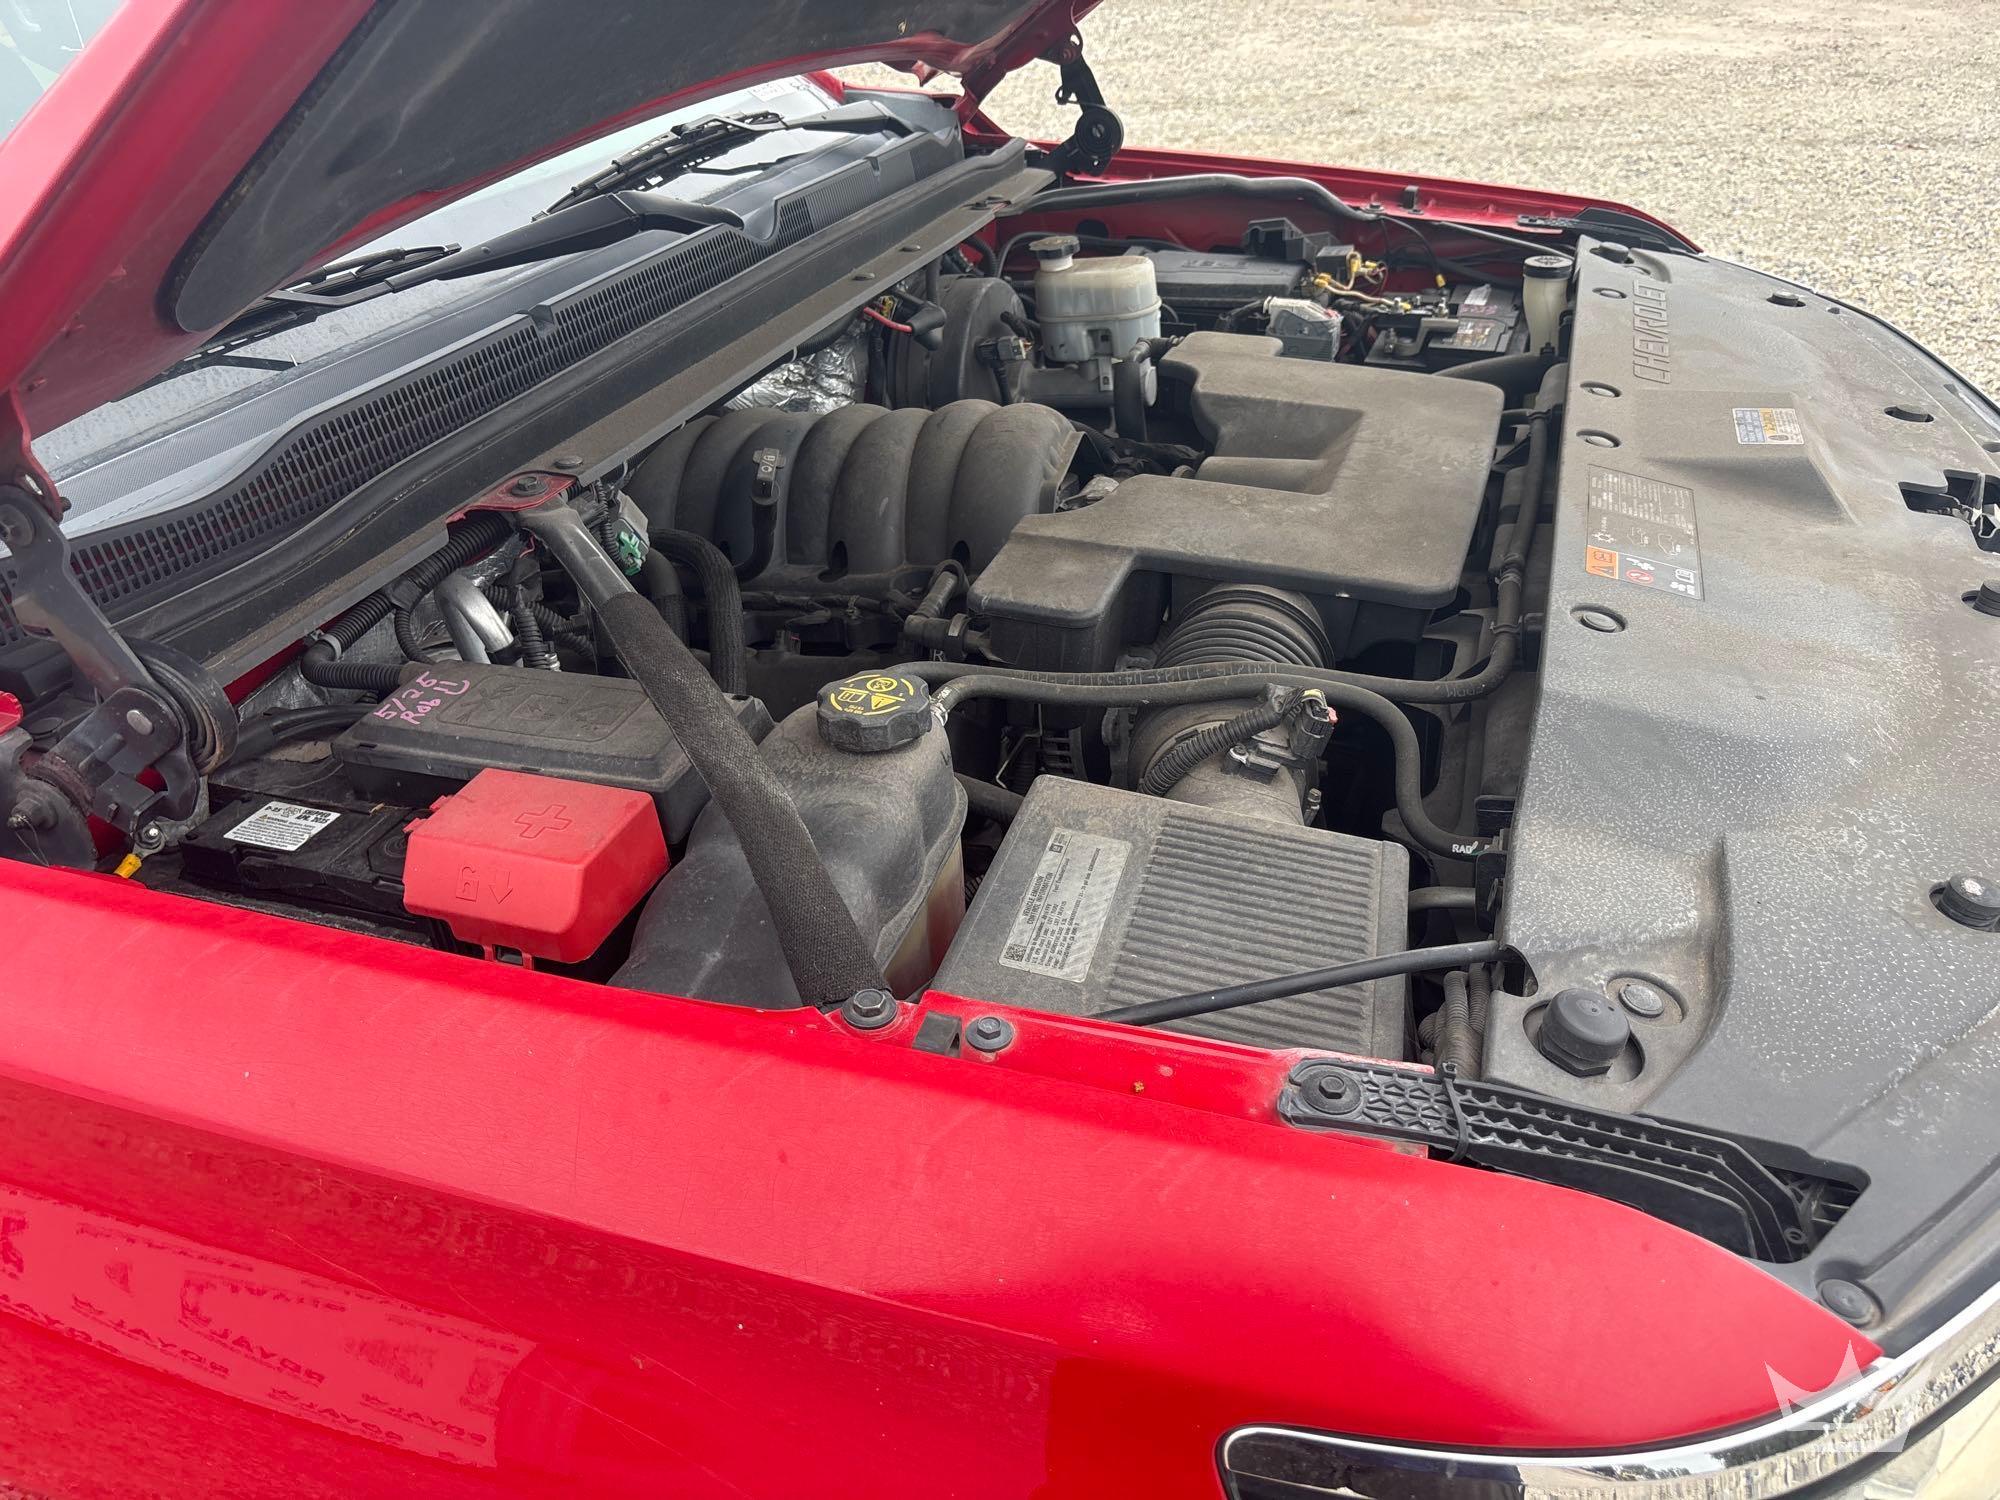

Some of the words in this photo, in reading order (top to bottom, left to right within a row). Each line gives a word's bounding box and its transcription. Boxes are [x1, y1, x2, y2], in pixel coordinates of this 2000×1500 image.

[1632, 279, 1671, 384] CHEVROLET
[400, 699, 440, 724] Rob
[1023, 897, 1035, 917] VEHICLE
[1027, 903, 1041, 925] CONTROL
